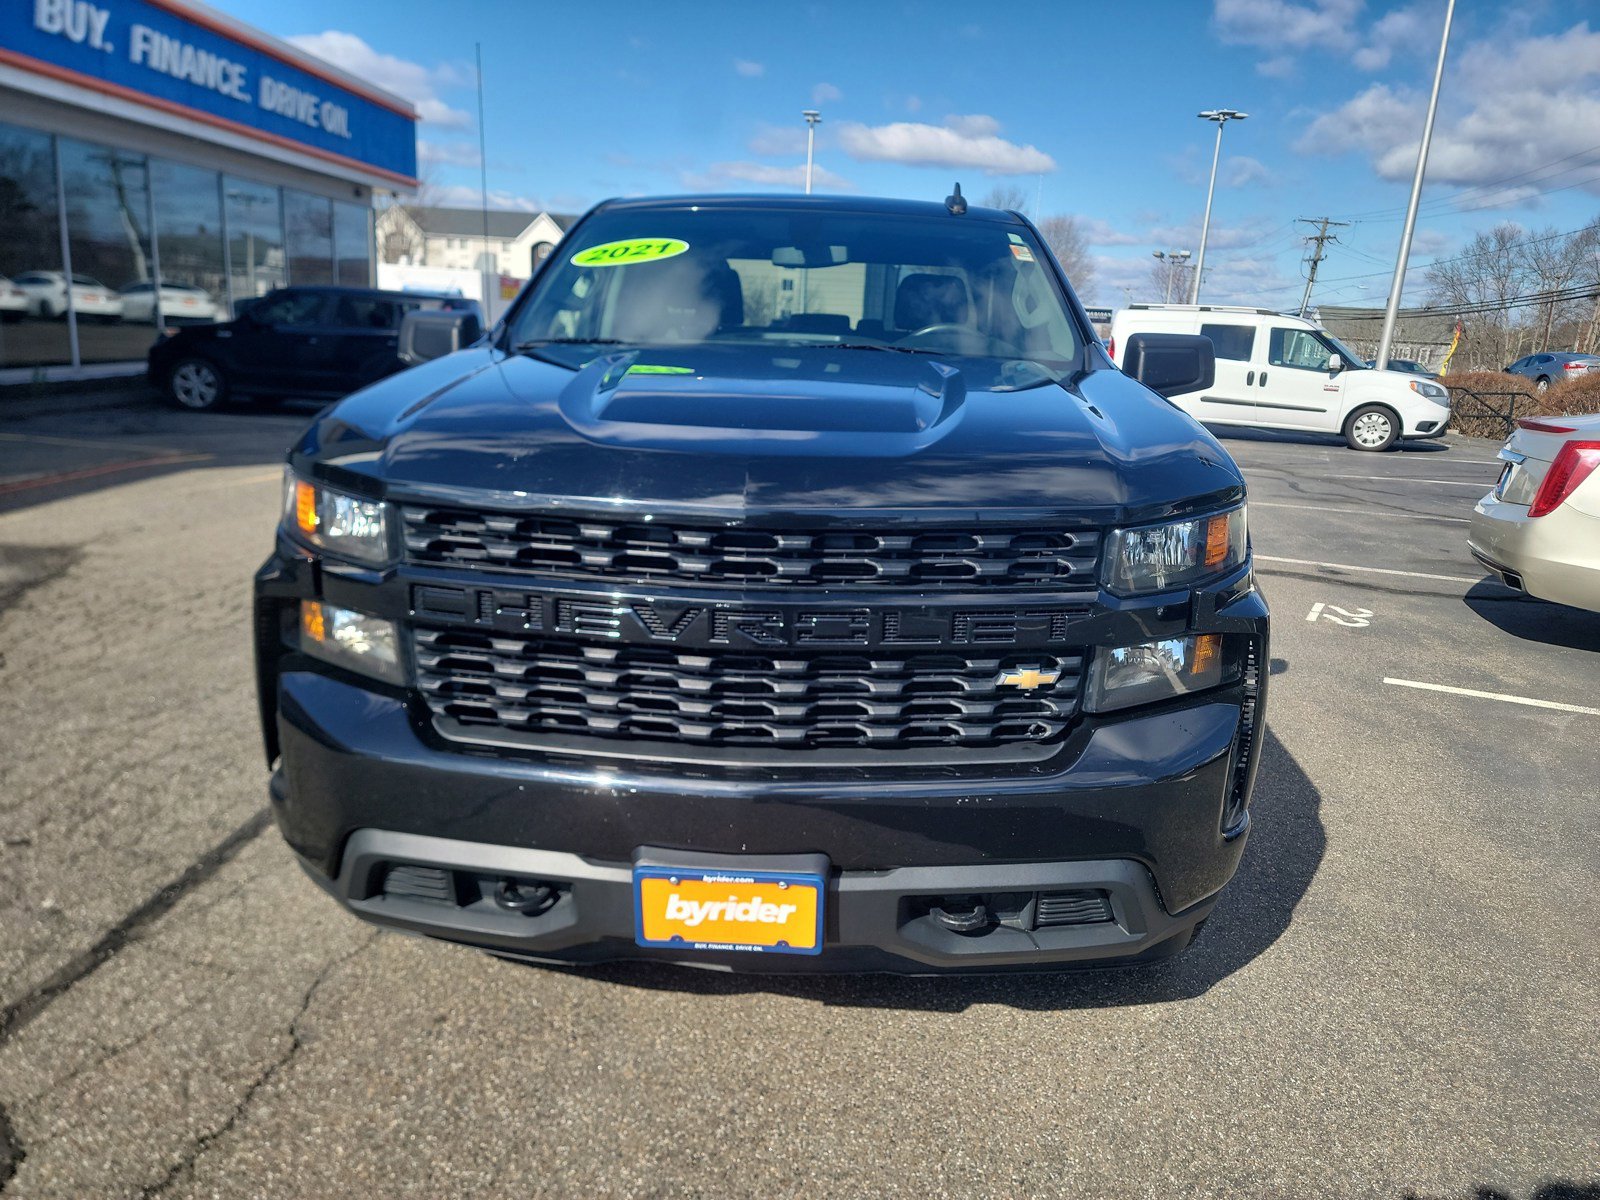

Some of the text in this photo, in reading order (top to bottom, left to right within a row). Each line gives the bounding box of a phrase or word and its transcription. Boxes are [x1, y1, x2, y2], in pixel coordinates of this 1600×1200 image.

[34, 0, 115, 54] BUY.
[130, 24, 252, 104] FINANCE.
[259, 76, 320, 129] DRIVE
[585, 242, 673, 262] 2021
[409, 583, 1095, 645] CHEVROLET
[702, 872, 755, 884] byrider.com
[665, 893, 797, 927] byrider
